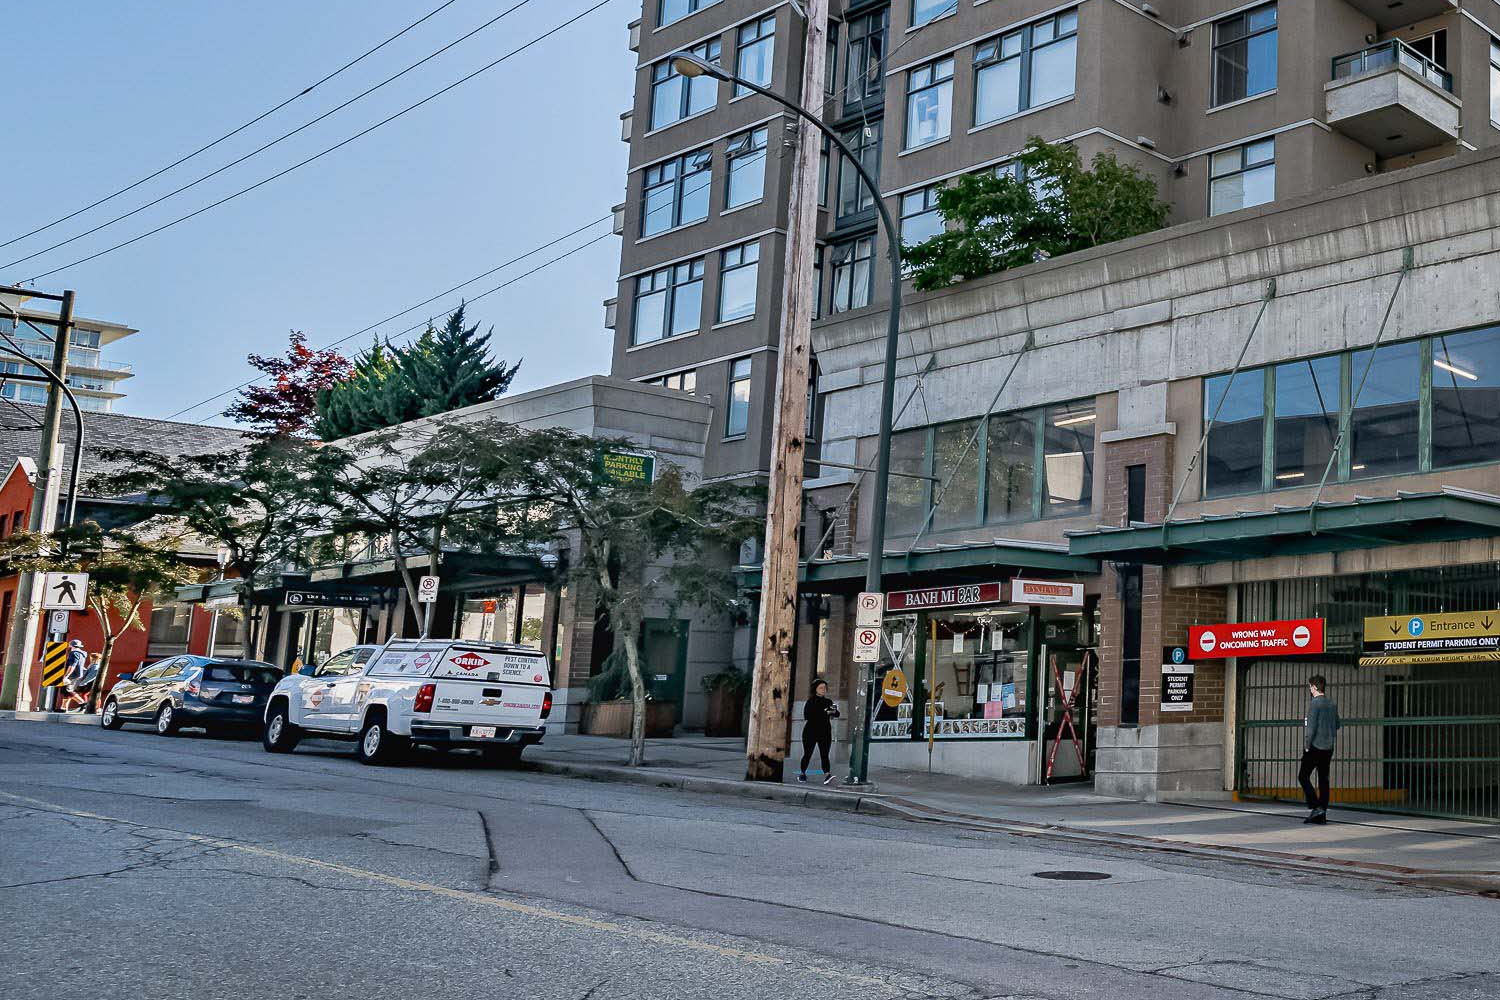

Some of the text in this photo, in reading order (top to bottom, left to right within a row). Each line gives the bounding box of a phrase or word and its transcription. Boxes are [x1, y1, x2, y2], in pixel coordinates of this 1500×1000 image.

[605, 461, 643, 471] PARKING
[905, 592, 938, 606] BANH
[957, 585, 980, 603] BAR
[1430, 620, 1475, 631] Entrance
[1231, 629, 1276, 639] WRONG WAY
[1220, 638, 1288, 649] ONCOMING TRAFFIC
[1384, 637, 1500, 650] STUDENT PERMIT PARKING ONLY
[454, 657, 485, 666] ORKIN
